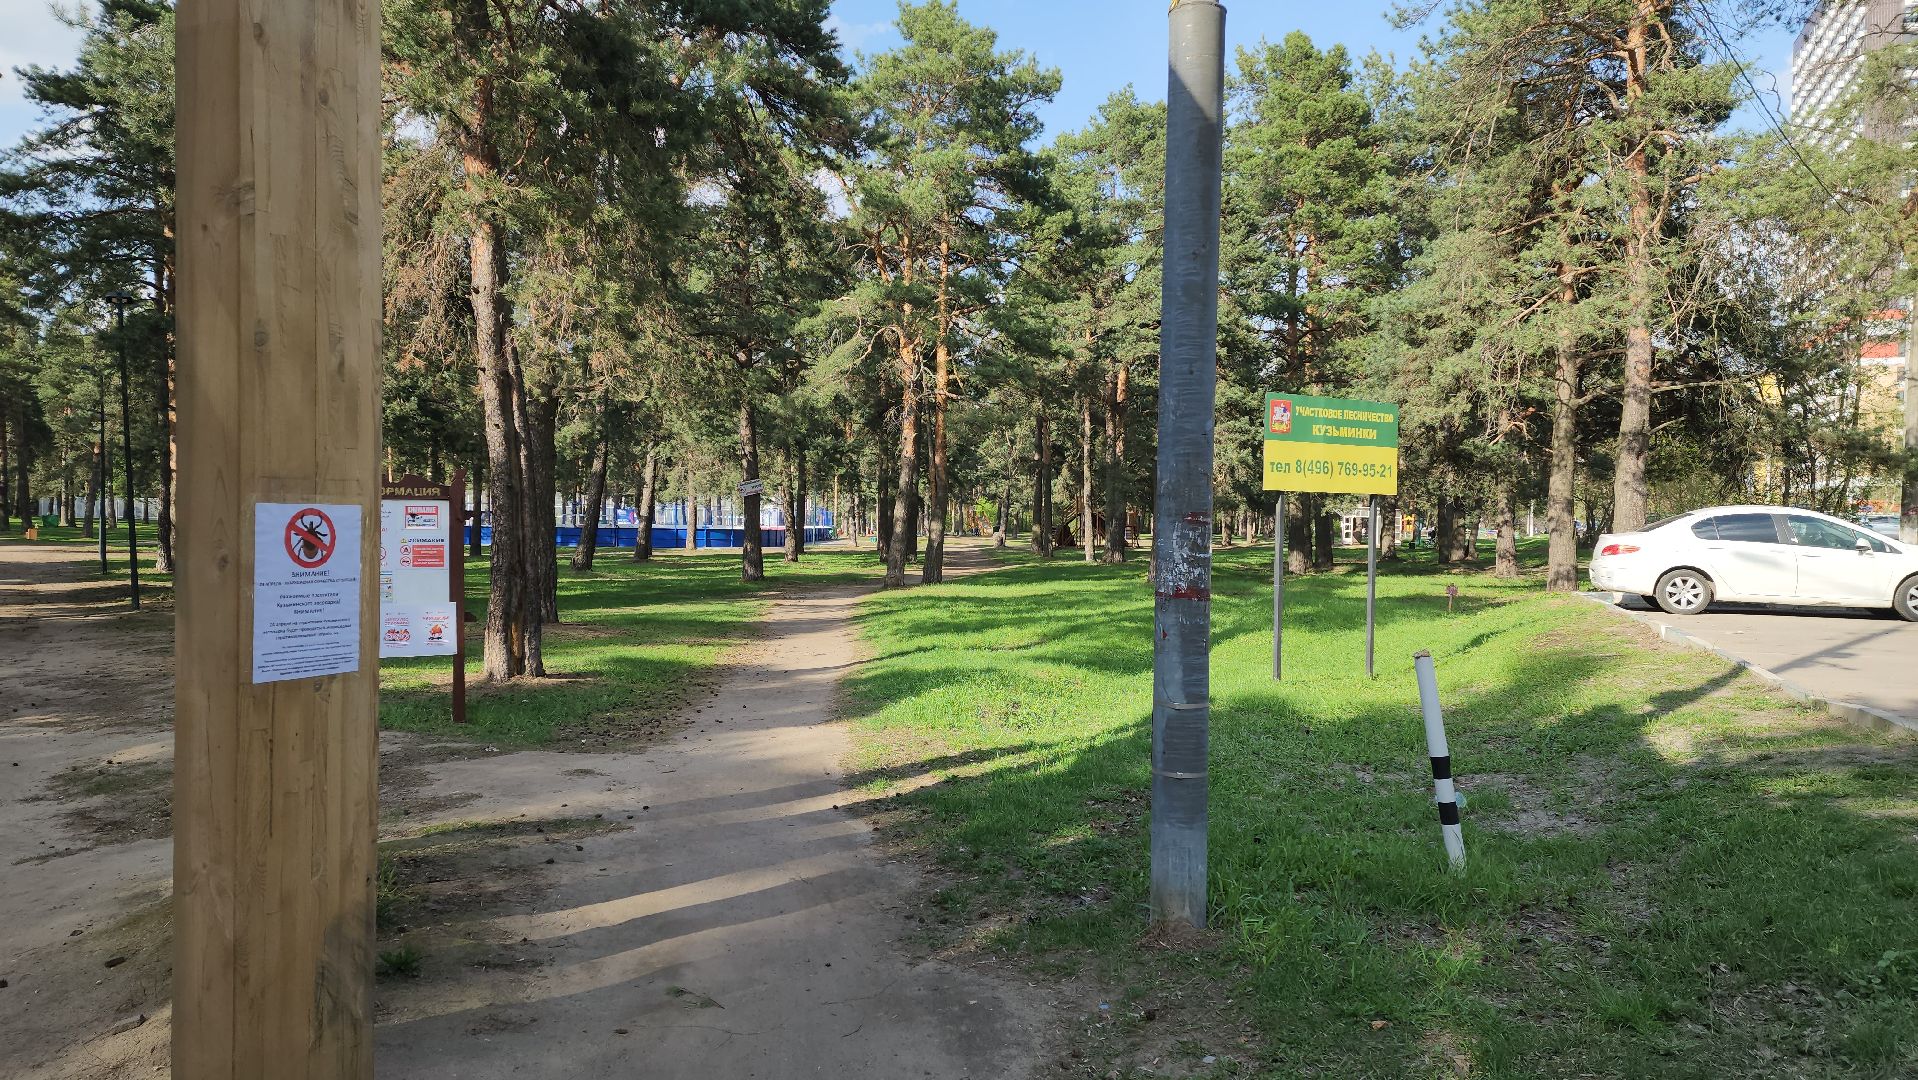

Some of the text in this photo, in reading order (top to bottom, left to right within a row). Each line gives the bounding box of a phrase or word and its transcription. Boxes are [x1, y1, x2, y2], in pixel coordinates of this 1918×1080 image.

[1295, 405, 1343, 420] УЧАСТКОВОЕ
[1312, 424, 1377, 440] КУЗЬМИНКИ
[1269, 459, 1392, 479] тел 8(496) 769-95-21
